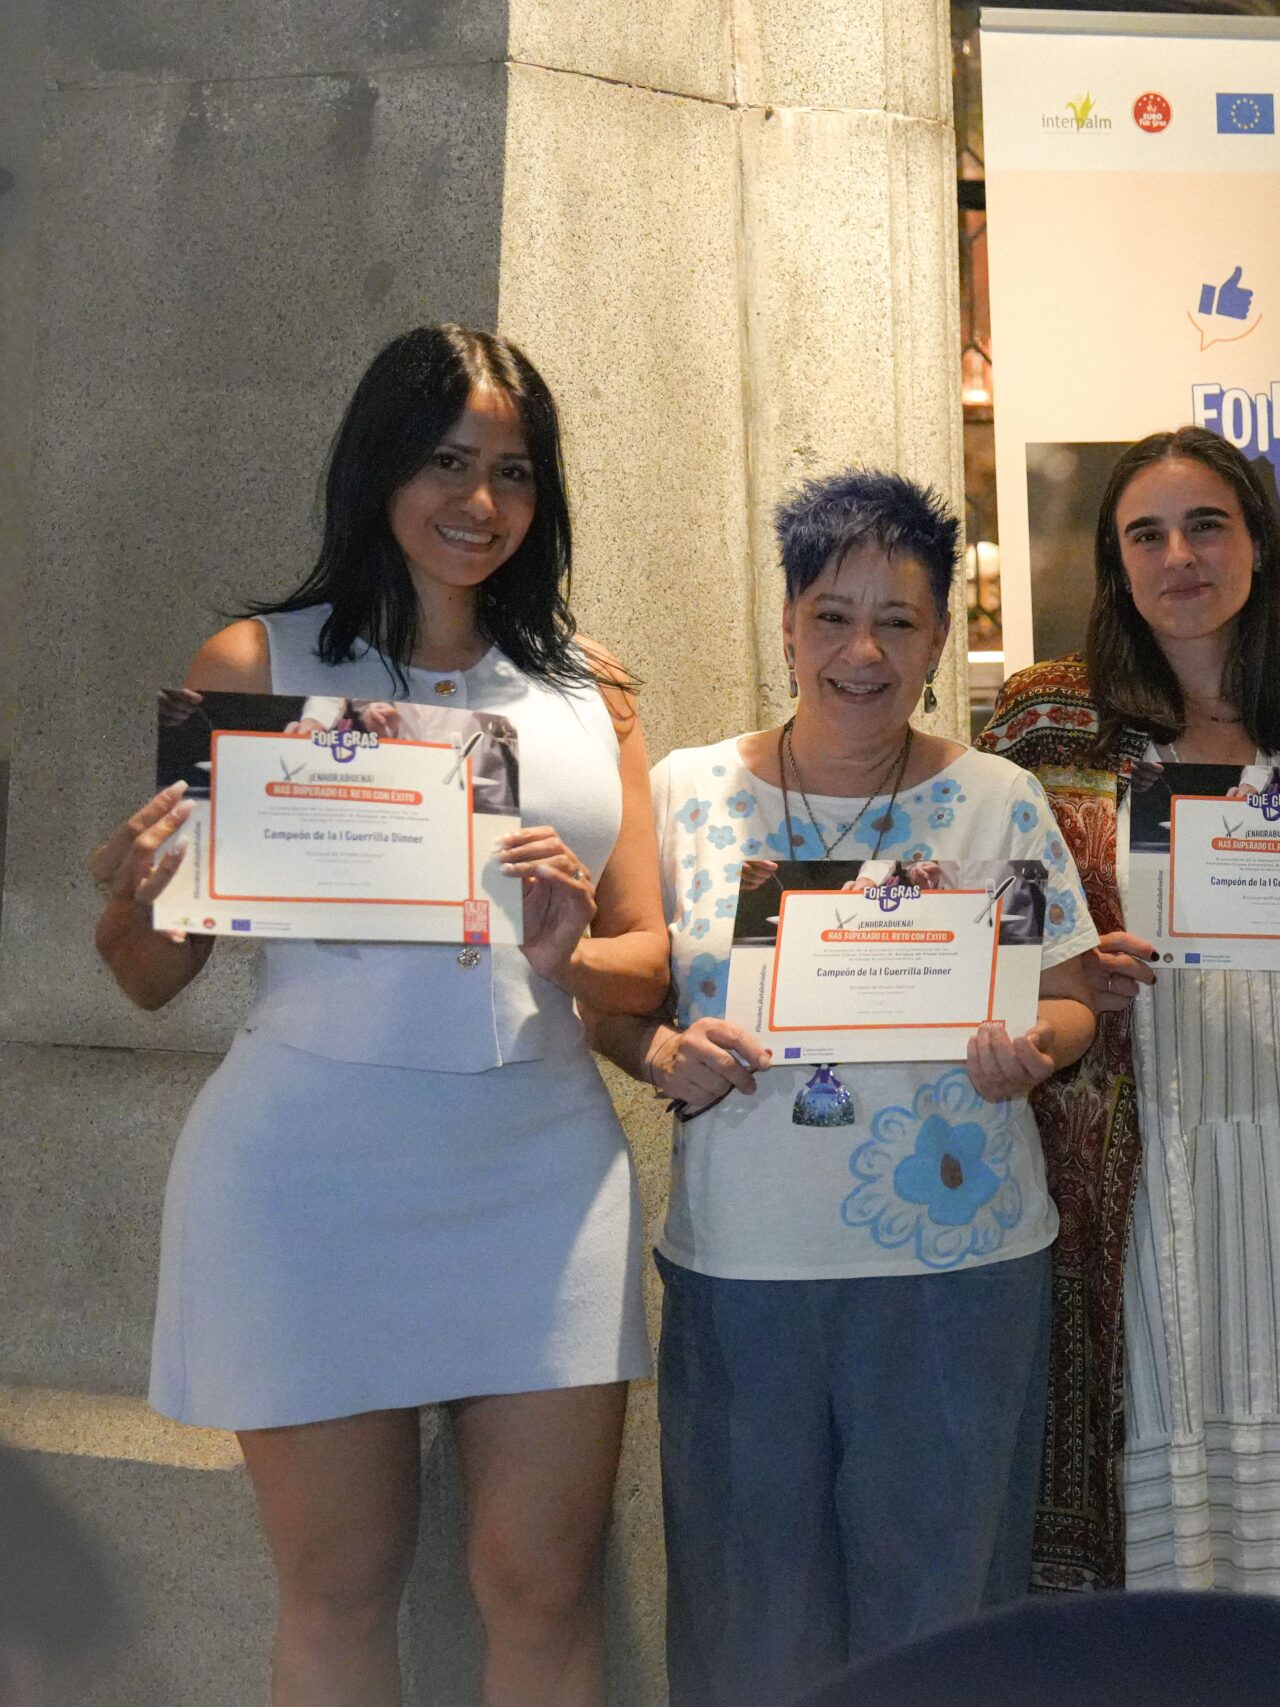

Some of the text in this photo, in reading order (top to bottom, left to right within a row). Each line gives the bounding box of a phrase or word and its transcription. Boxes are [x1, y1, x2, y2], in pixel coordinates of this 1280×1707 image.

[1042, 113, 1112, 132] interpalm
[311, 730, 379, 748] FOIE GRAS
[1247, 794, 1269, 807] FOIE
[264, 828, 310, 842] Campeón
[313, 830, 325, 841] de
[328, 830, 337, 841] la
[345, 831, 389, 843] Guerrilla
[392, 832, 423, 844] Dinner
[1218, 840, 1232, 849] HAS
[1233, 841, 1267, 851] SUPERADO
[1268, 843, 1276, 851] EL
[1211, 876, 1247, 888] Campeón
[1248, 878, 1258, 887] de
[1260, 879, 1267, 887] la
[864, 885, 920, 899] FOIE GRAS
[858, 920, 913, 929] ¡ENHORABUENA!
[828, 930, 947, 941] HAS SUPERADO EL RETO CON ÉXITO
[817, 967, 855, 978] Campeón
[857, 968, 867, 977] de
[869, 968, 877, 977] la
[884, 967, 921, 977] Guerrilla
[923, 966, 952, 976] Dinner
